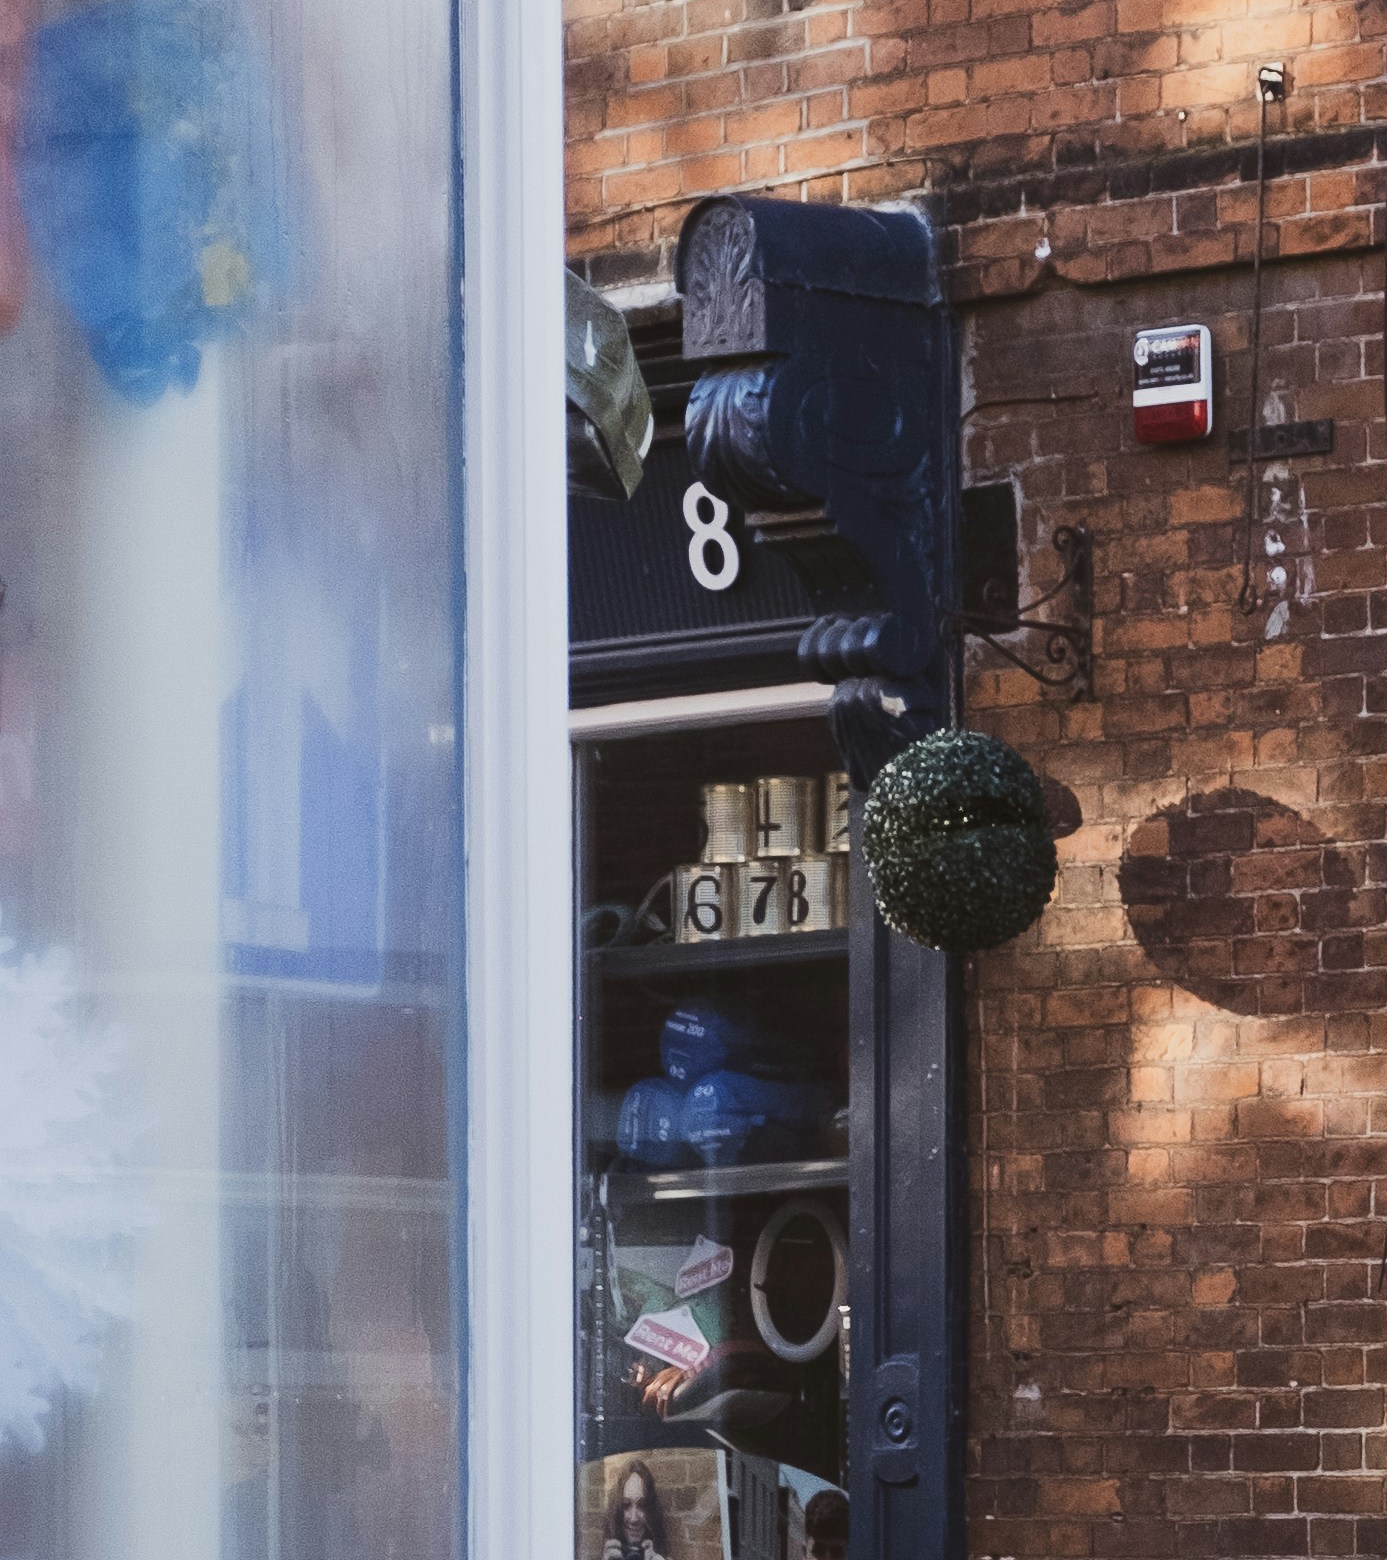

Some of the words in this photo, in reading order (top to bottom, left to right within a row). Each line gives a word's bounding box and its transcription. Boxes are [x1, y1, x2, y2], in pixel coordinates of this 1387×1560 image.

[682, 481, 739, 590] 8
[686, 875, 722, 933] 6
[750, 876, 778, 924] 7
[788, 870, 809, 924] 8
